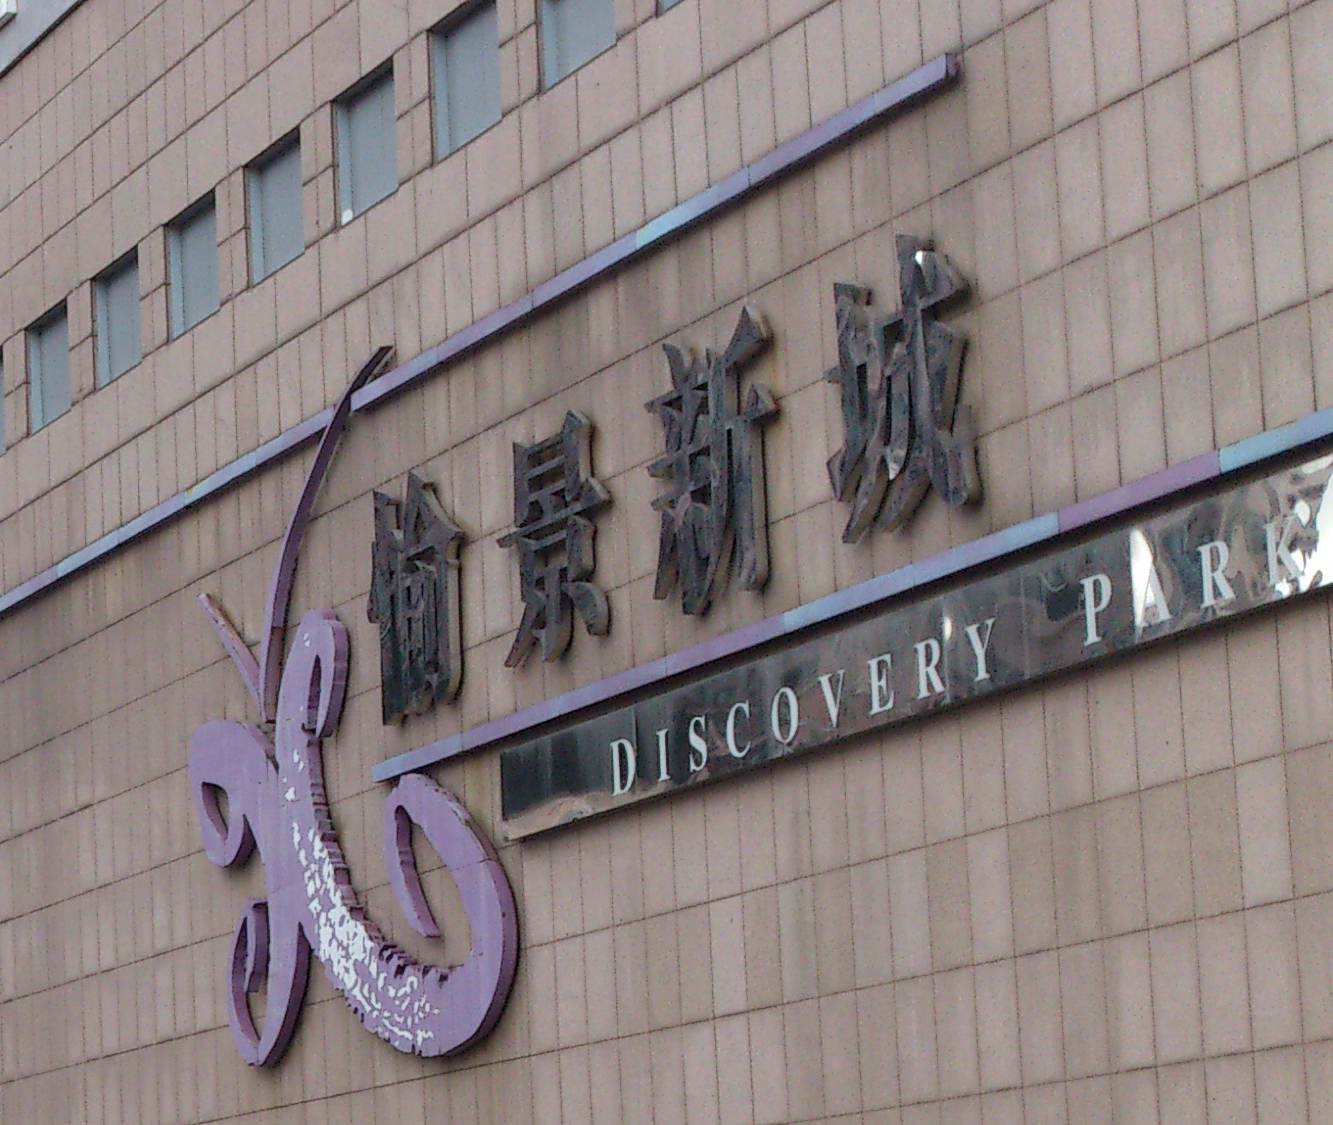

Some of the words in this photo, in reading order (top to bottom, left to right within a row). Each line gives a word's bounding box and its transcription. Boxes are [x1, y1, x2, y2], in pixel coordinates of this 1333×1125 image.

[369, 234, 983, 726] 愉景新城
[610, 617, 995, 797] DISCOVERY
[1081, 514, 1305, 647] PARK
